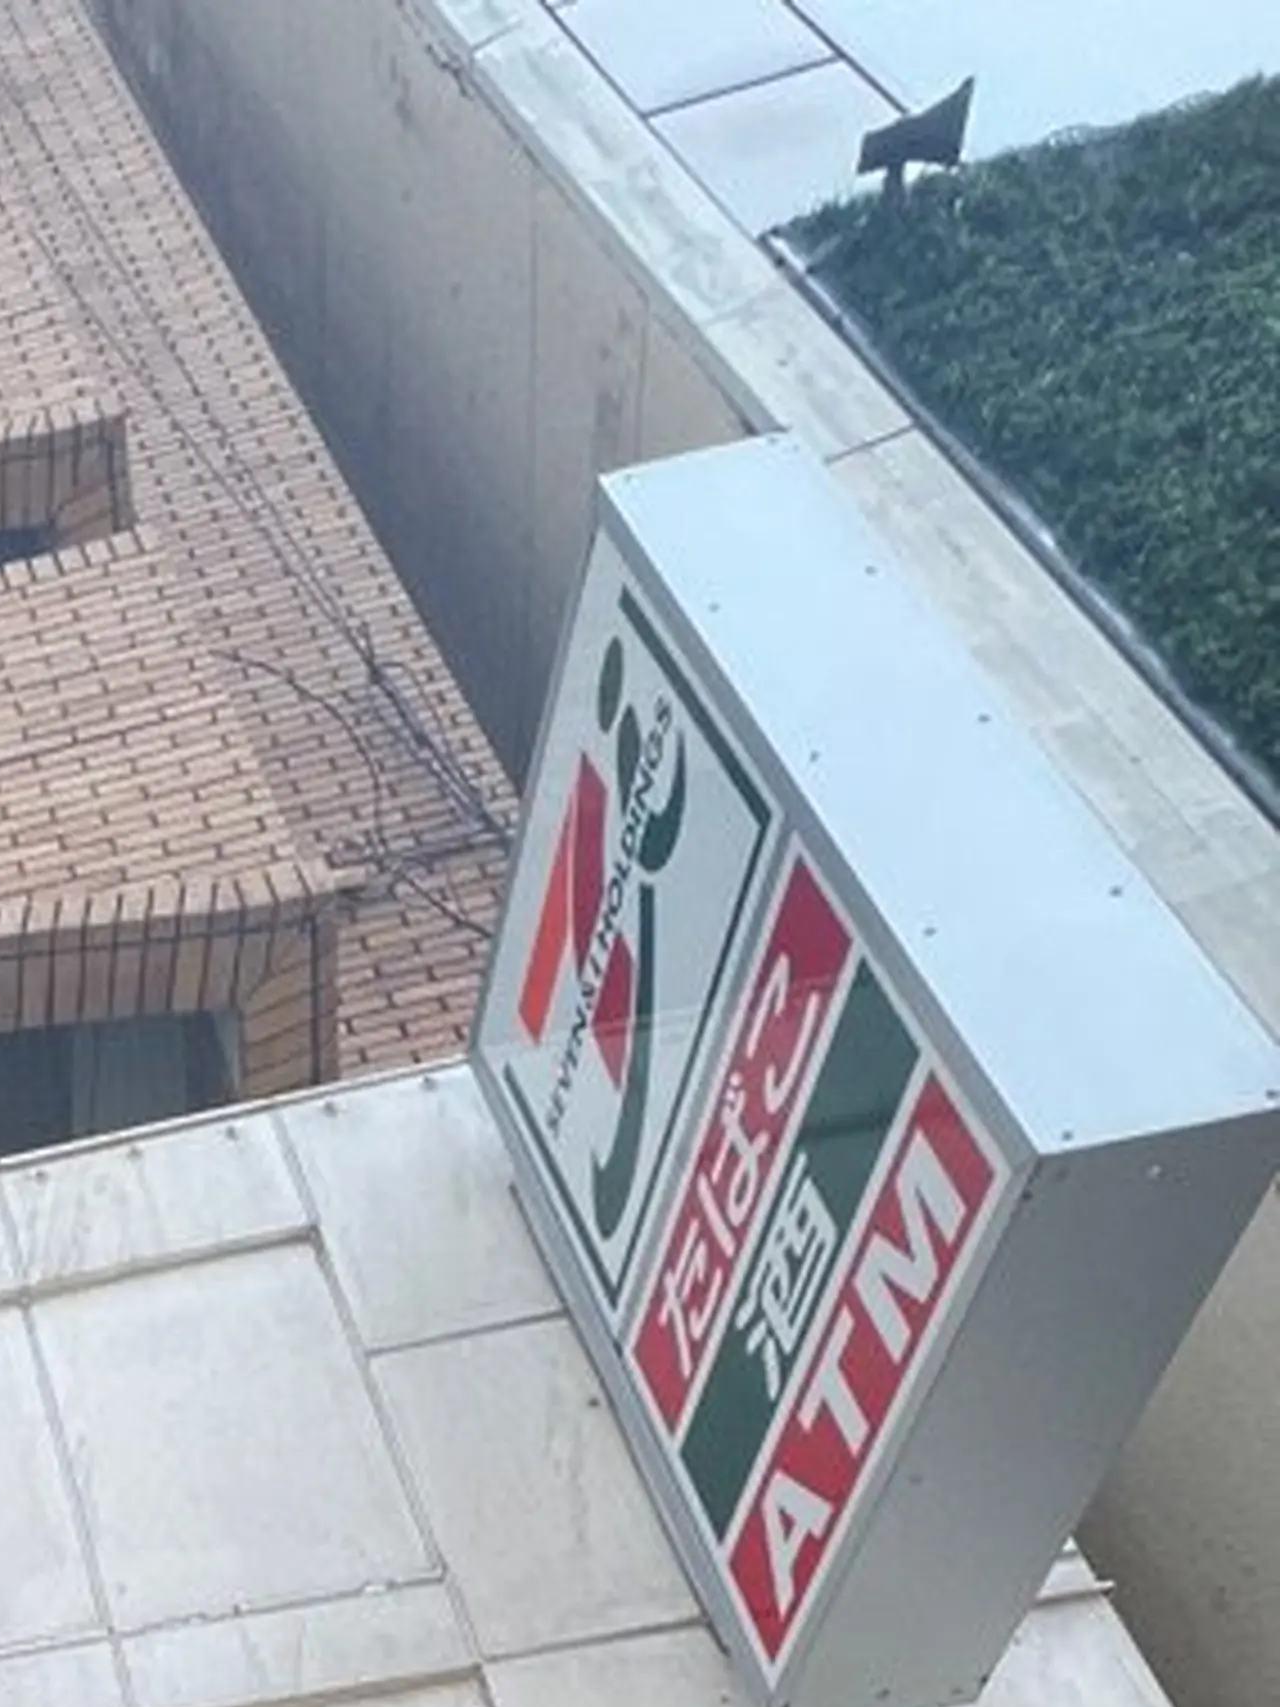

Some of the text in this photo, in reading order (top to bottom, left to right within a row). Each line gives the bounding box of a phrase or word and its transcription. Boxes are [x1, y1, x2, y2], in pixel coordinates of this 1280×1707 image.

[658, 951, 820, 1379] たばこ
[737, 1149, 840, 1401] 酒
[760, 1127, 969, 1618] ATM
